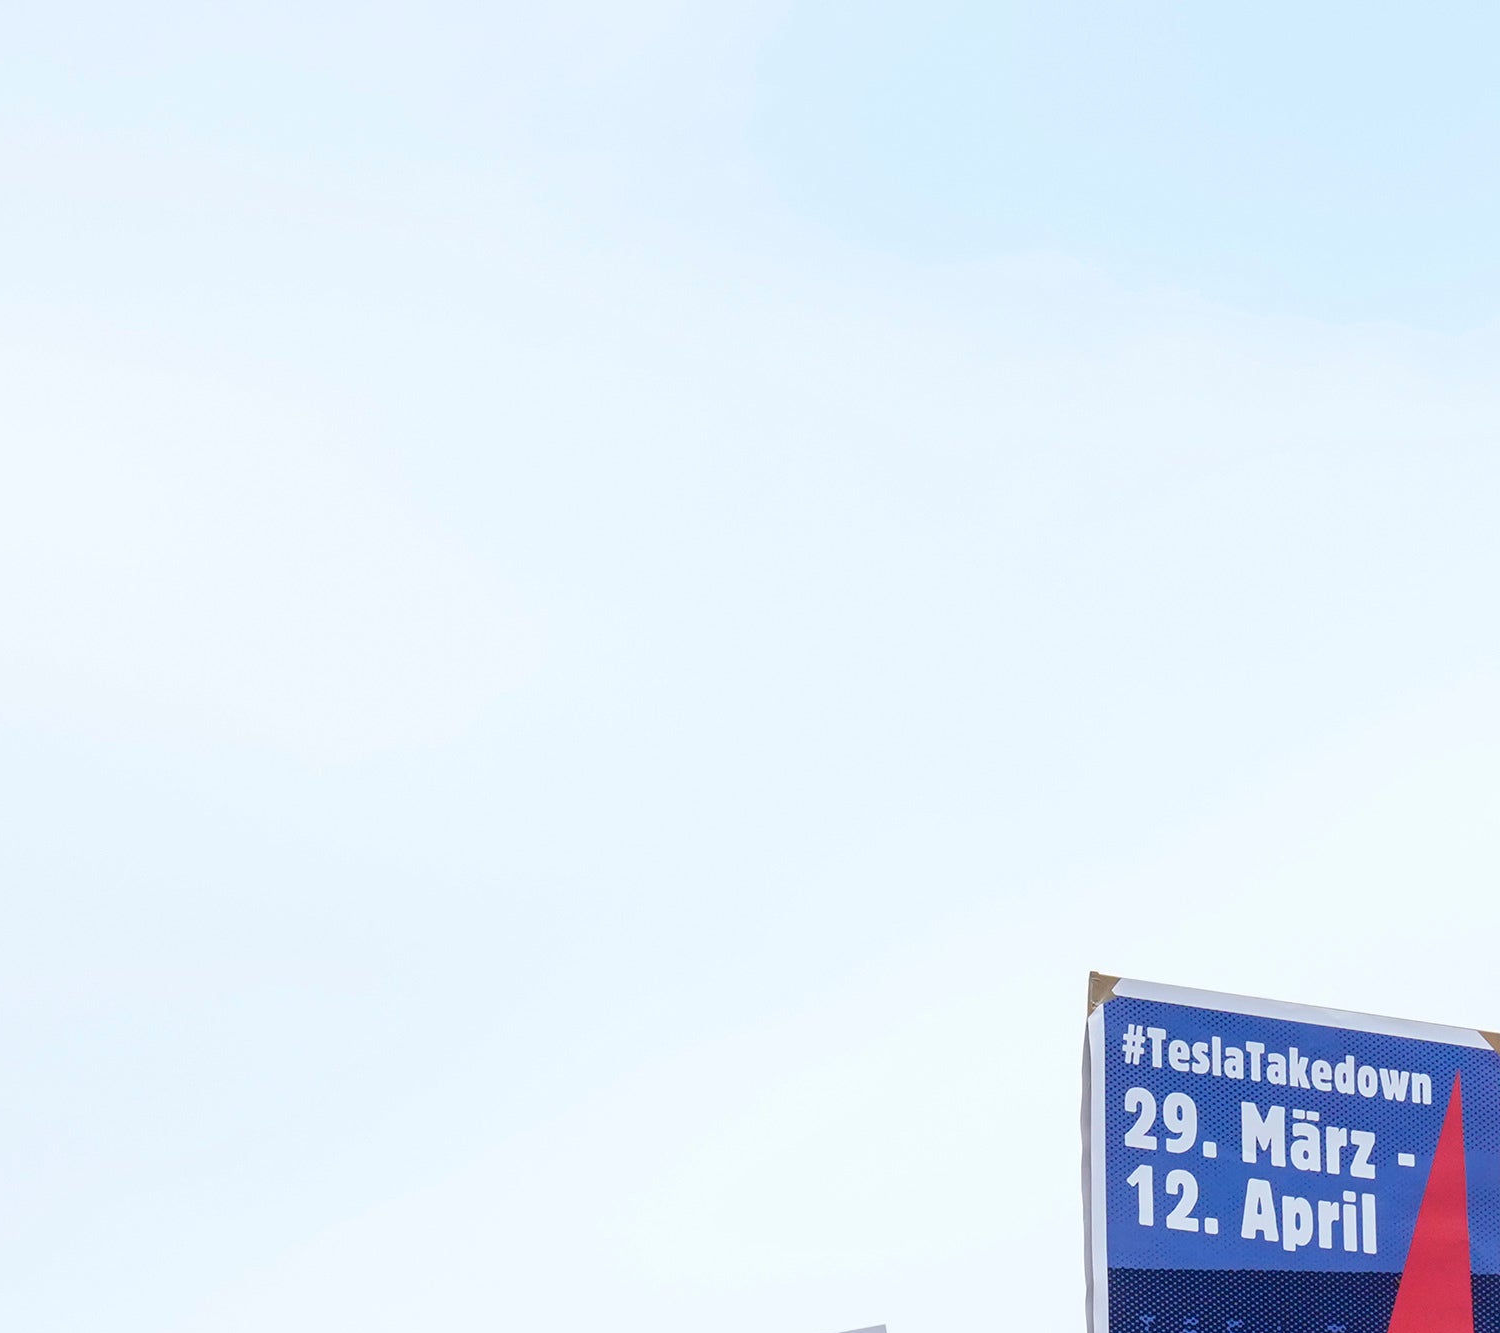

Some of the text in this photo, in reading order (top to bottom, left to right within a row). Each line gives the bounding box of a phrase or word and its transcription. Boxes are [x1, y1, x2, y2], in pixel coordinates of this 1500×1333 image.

[1122, 1024, 1432, 1106] #TeslaTakedown
[1124, 1087, 1416, 1179] 29. März -
[1126, 1163, 1378, 1256] 12. April
